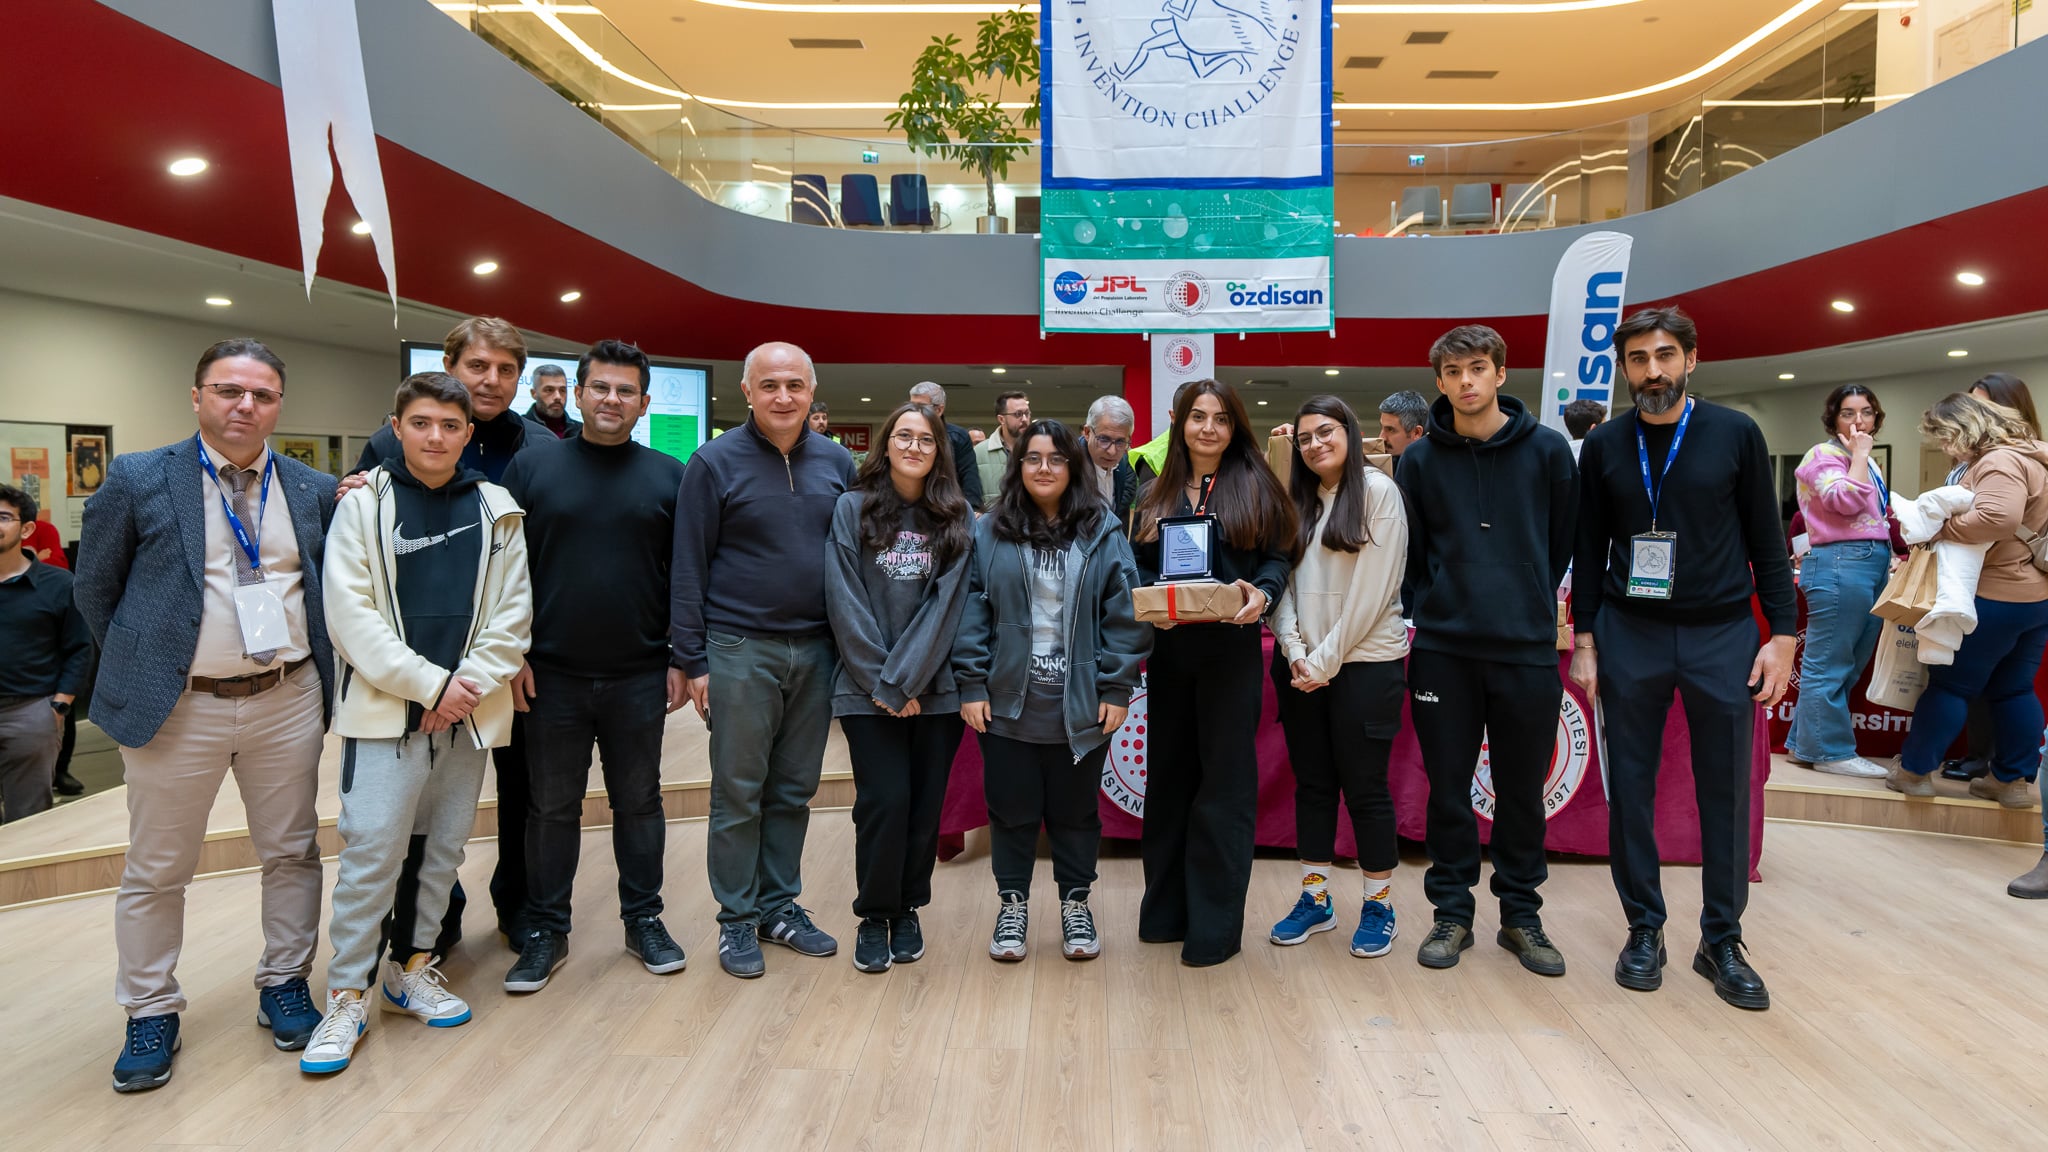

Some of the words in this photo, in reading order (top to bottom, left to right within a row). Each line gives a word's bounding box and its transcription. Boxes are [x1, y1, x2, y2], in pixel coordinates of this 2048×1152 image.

[1073, 31, 1176, 128] INVENTION
[1184, 27, 1300, 130] CHALLENGE
[1056, 283, 1086, 292] NASA
[1093, 276, 1147, 292] JPL
[1226, 282, 1323, 306] özdisan
[1558, 271, 1623, 416] isan
